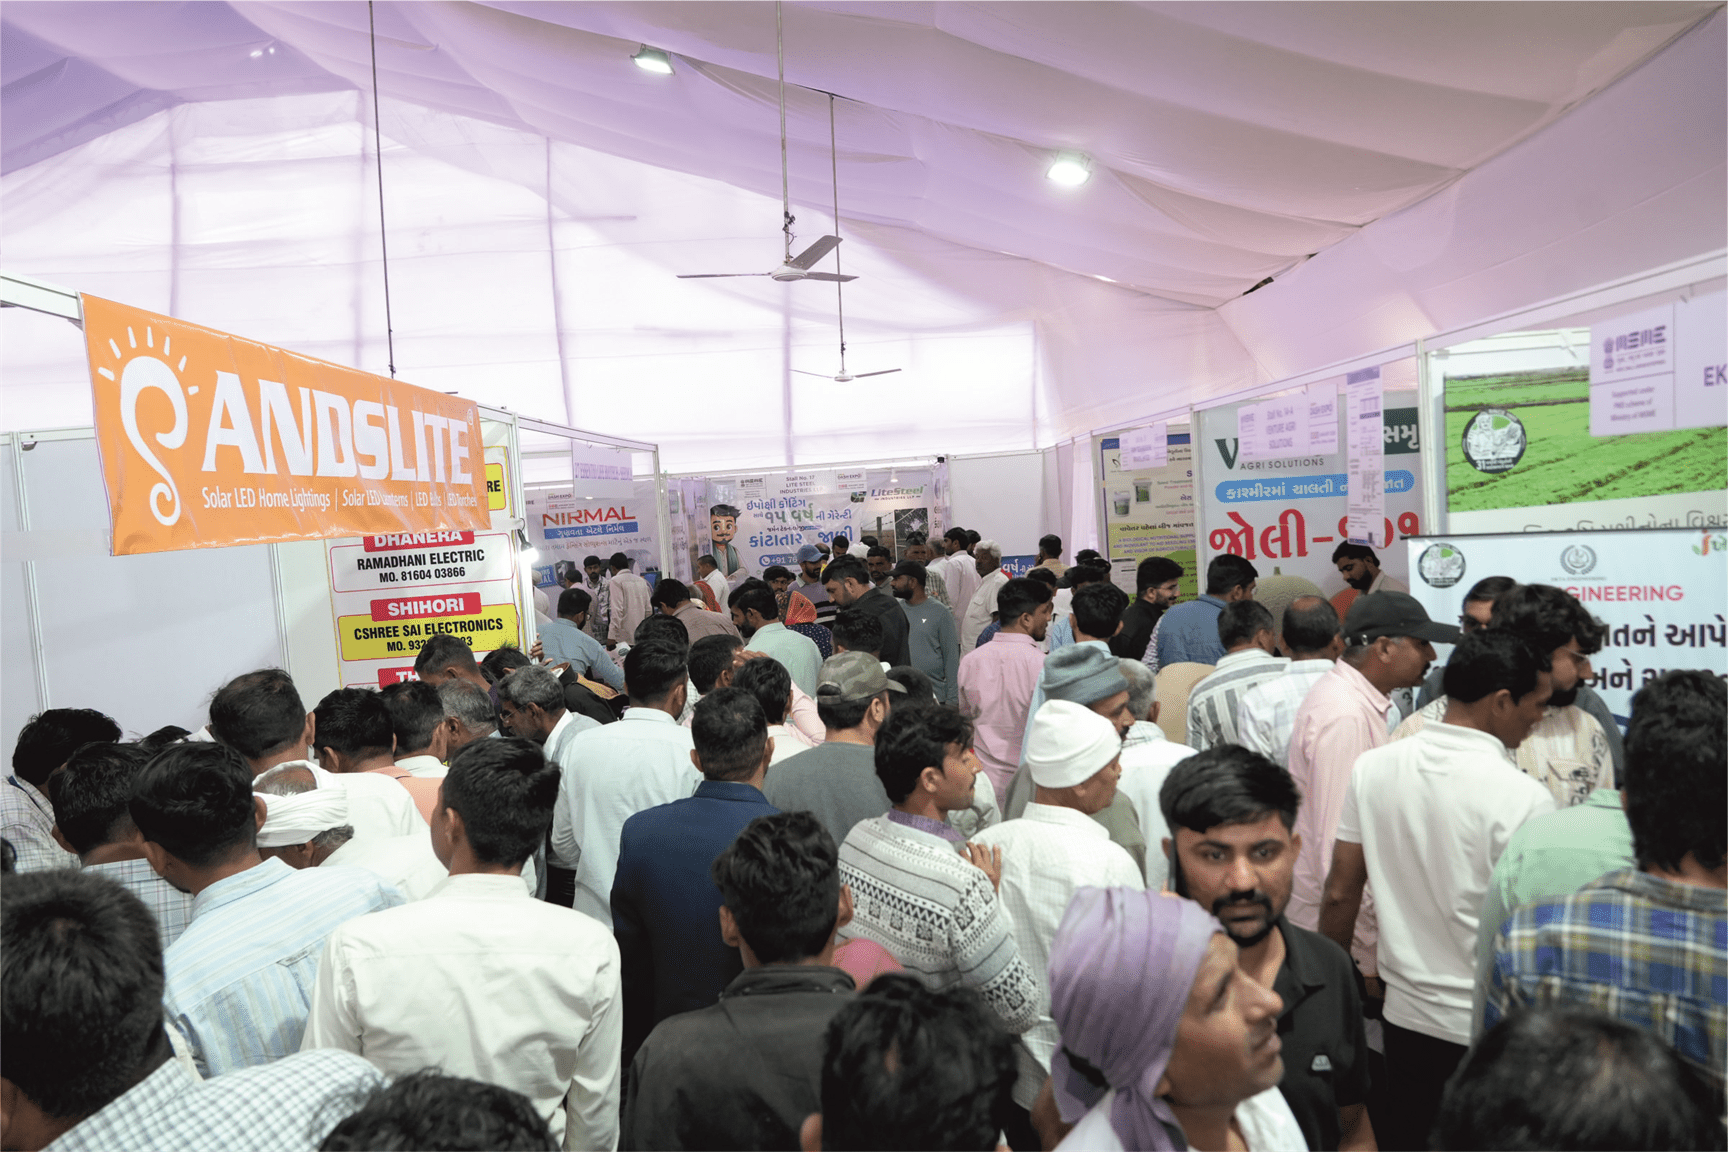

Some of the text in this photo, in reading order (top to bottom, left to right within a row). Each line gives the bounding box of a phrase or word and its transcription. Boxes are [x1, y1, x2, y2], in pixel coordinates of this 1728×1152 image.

[1240, 458, 1324, 471] AGRI SOLUTIONS
[201, 486, 232, 508] Solar
[234, 487, 256, 508] LED
[259, 487, 289, 508] Home
[290, 488, 331, 512] Lightings
[342, 489, 366, 507] Solar
[415, 492, 428, 507] LED
[871, 486, 924, 497] LiteSteel
[542, 506, 636, 526] NIRMAL
[374, 531, 464, 547] DHANERA
[749, 531, 803, 548] કાંટાતાર
[357, 549, 485, 571] RAMADHANI ELECTRIC
[379, 566, 466, 583] MO. 81604 03866
[1566, 585, 1684, 601] GINEERING
[387, 597, 465, 617] SHIHORI
[354, 618, 503, 641] CSHREE SAI ELECTRONICS
[387, 639, 427, 652] MO. 932
